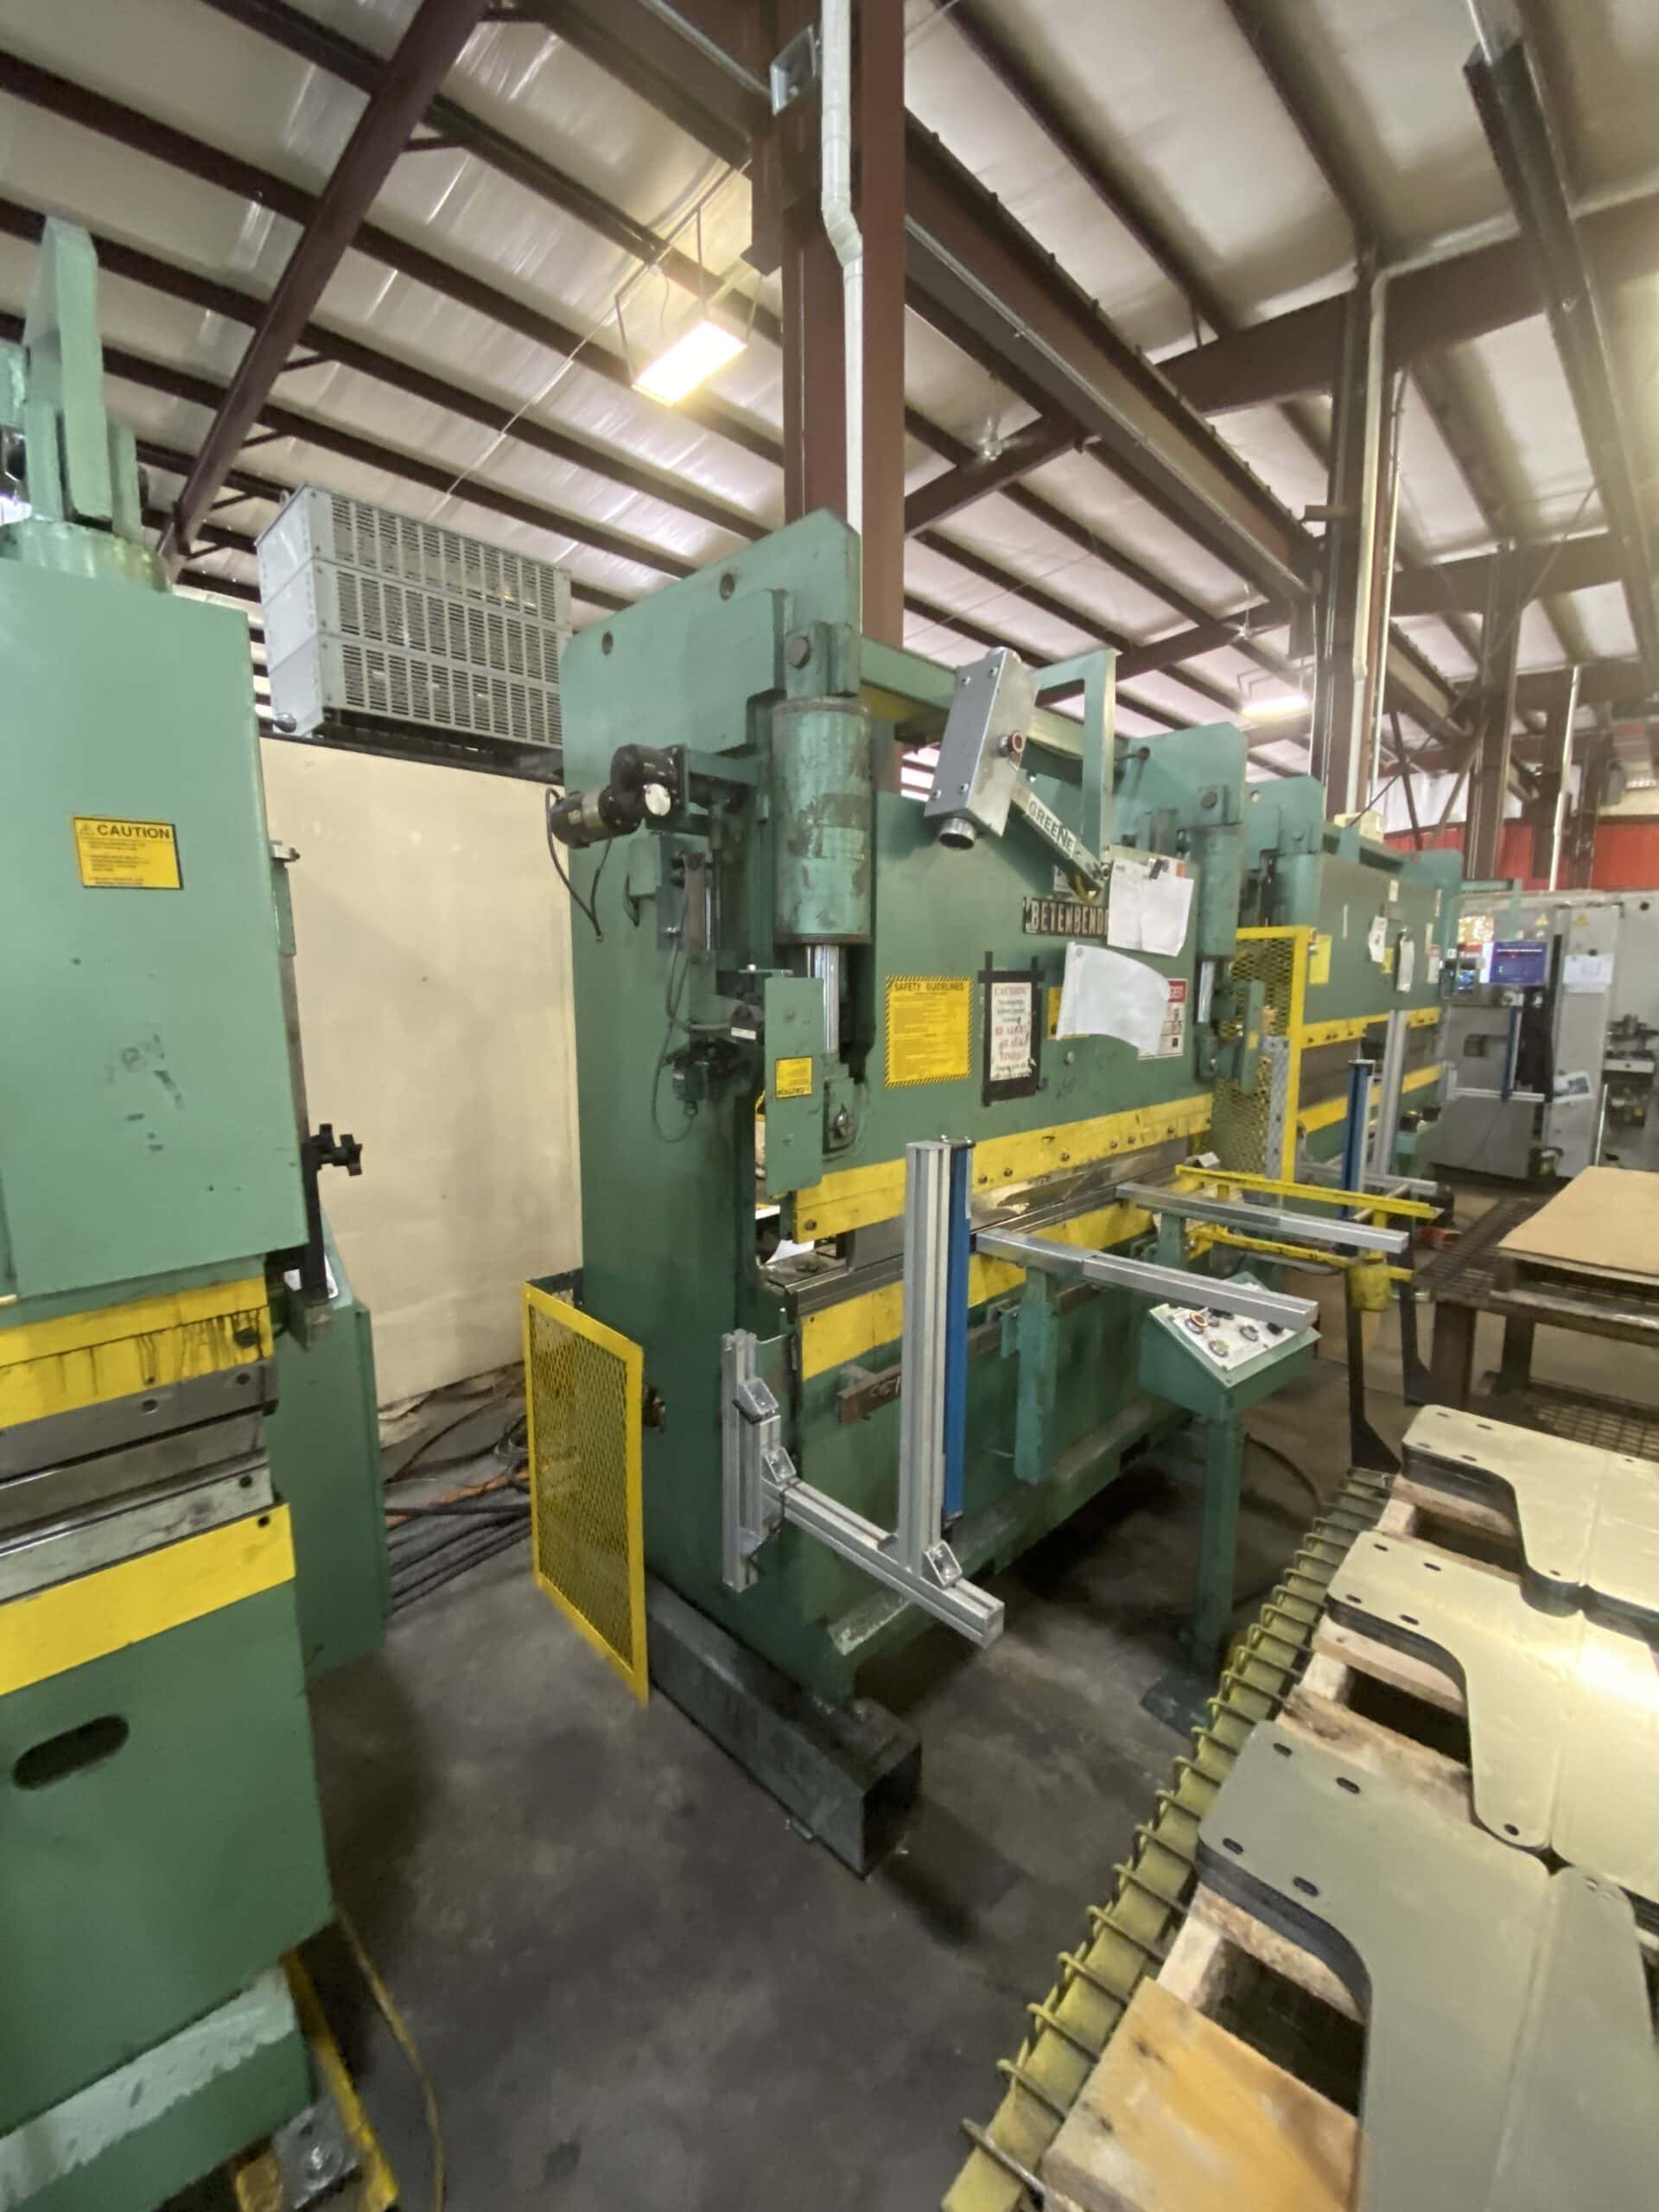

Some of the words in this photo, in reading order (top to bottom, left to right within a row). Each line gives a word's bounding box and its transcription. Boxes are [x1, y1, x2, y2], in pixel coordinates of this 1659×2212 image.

[97, 824, 170, 839] CAUTION
[1029, 800, 1074, 853] GREENE
[894, 982, 922, 991] SAFETY
[926, 982, 964, 991] GUIDELINES
